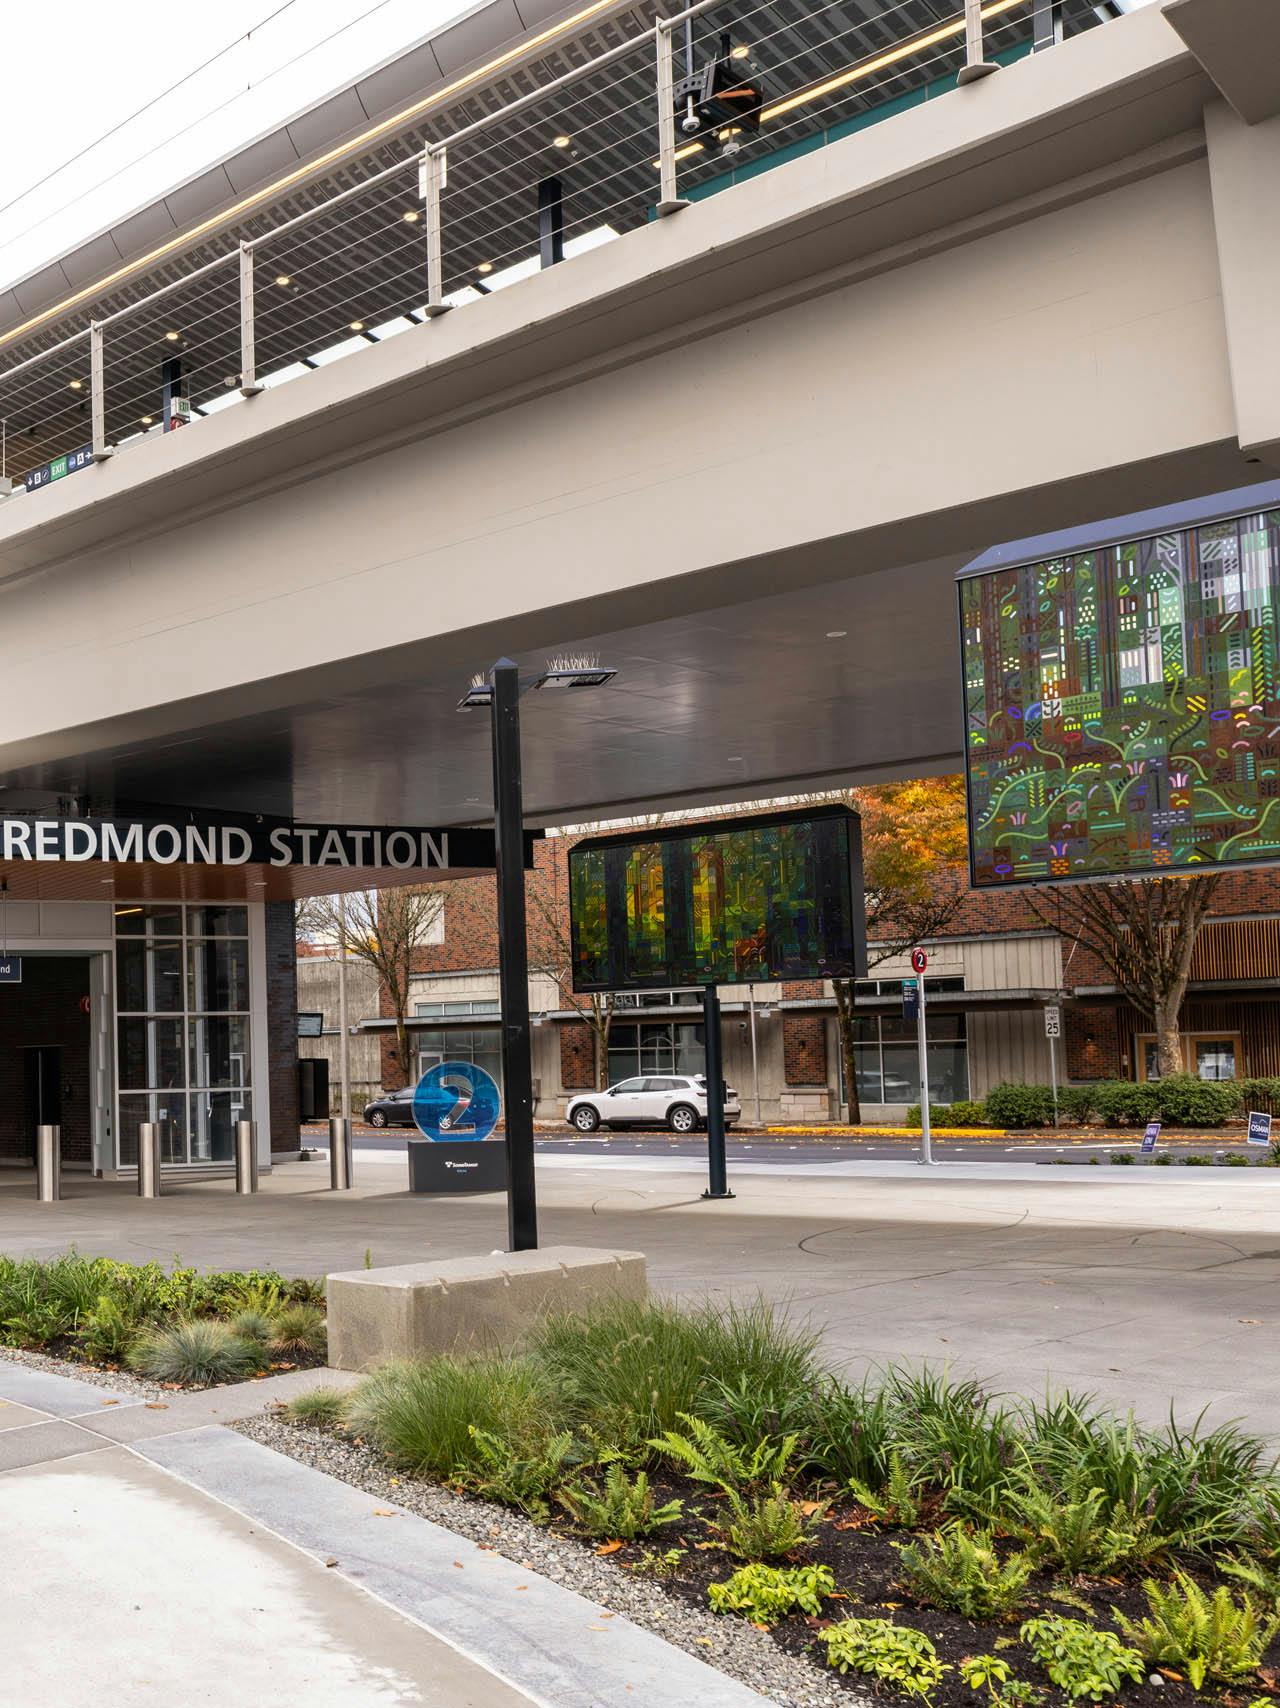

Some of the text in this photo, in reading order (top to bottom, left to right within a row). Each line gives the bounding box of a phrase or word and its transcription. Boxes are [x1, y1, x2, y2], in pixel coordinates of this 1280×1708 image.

[51, 462, 65, 476] EXIT
[3, 820, 252, 865] REDMOND
[269, 827, 448, 869] STATION
[917, 953, 924, 968] 2
[1047, 1022, 1059, 1034] 25
[439, 1074, 476, 1135] 2
[1251, 1124, 1269, 1133] OSMAN
